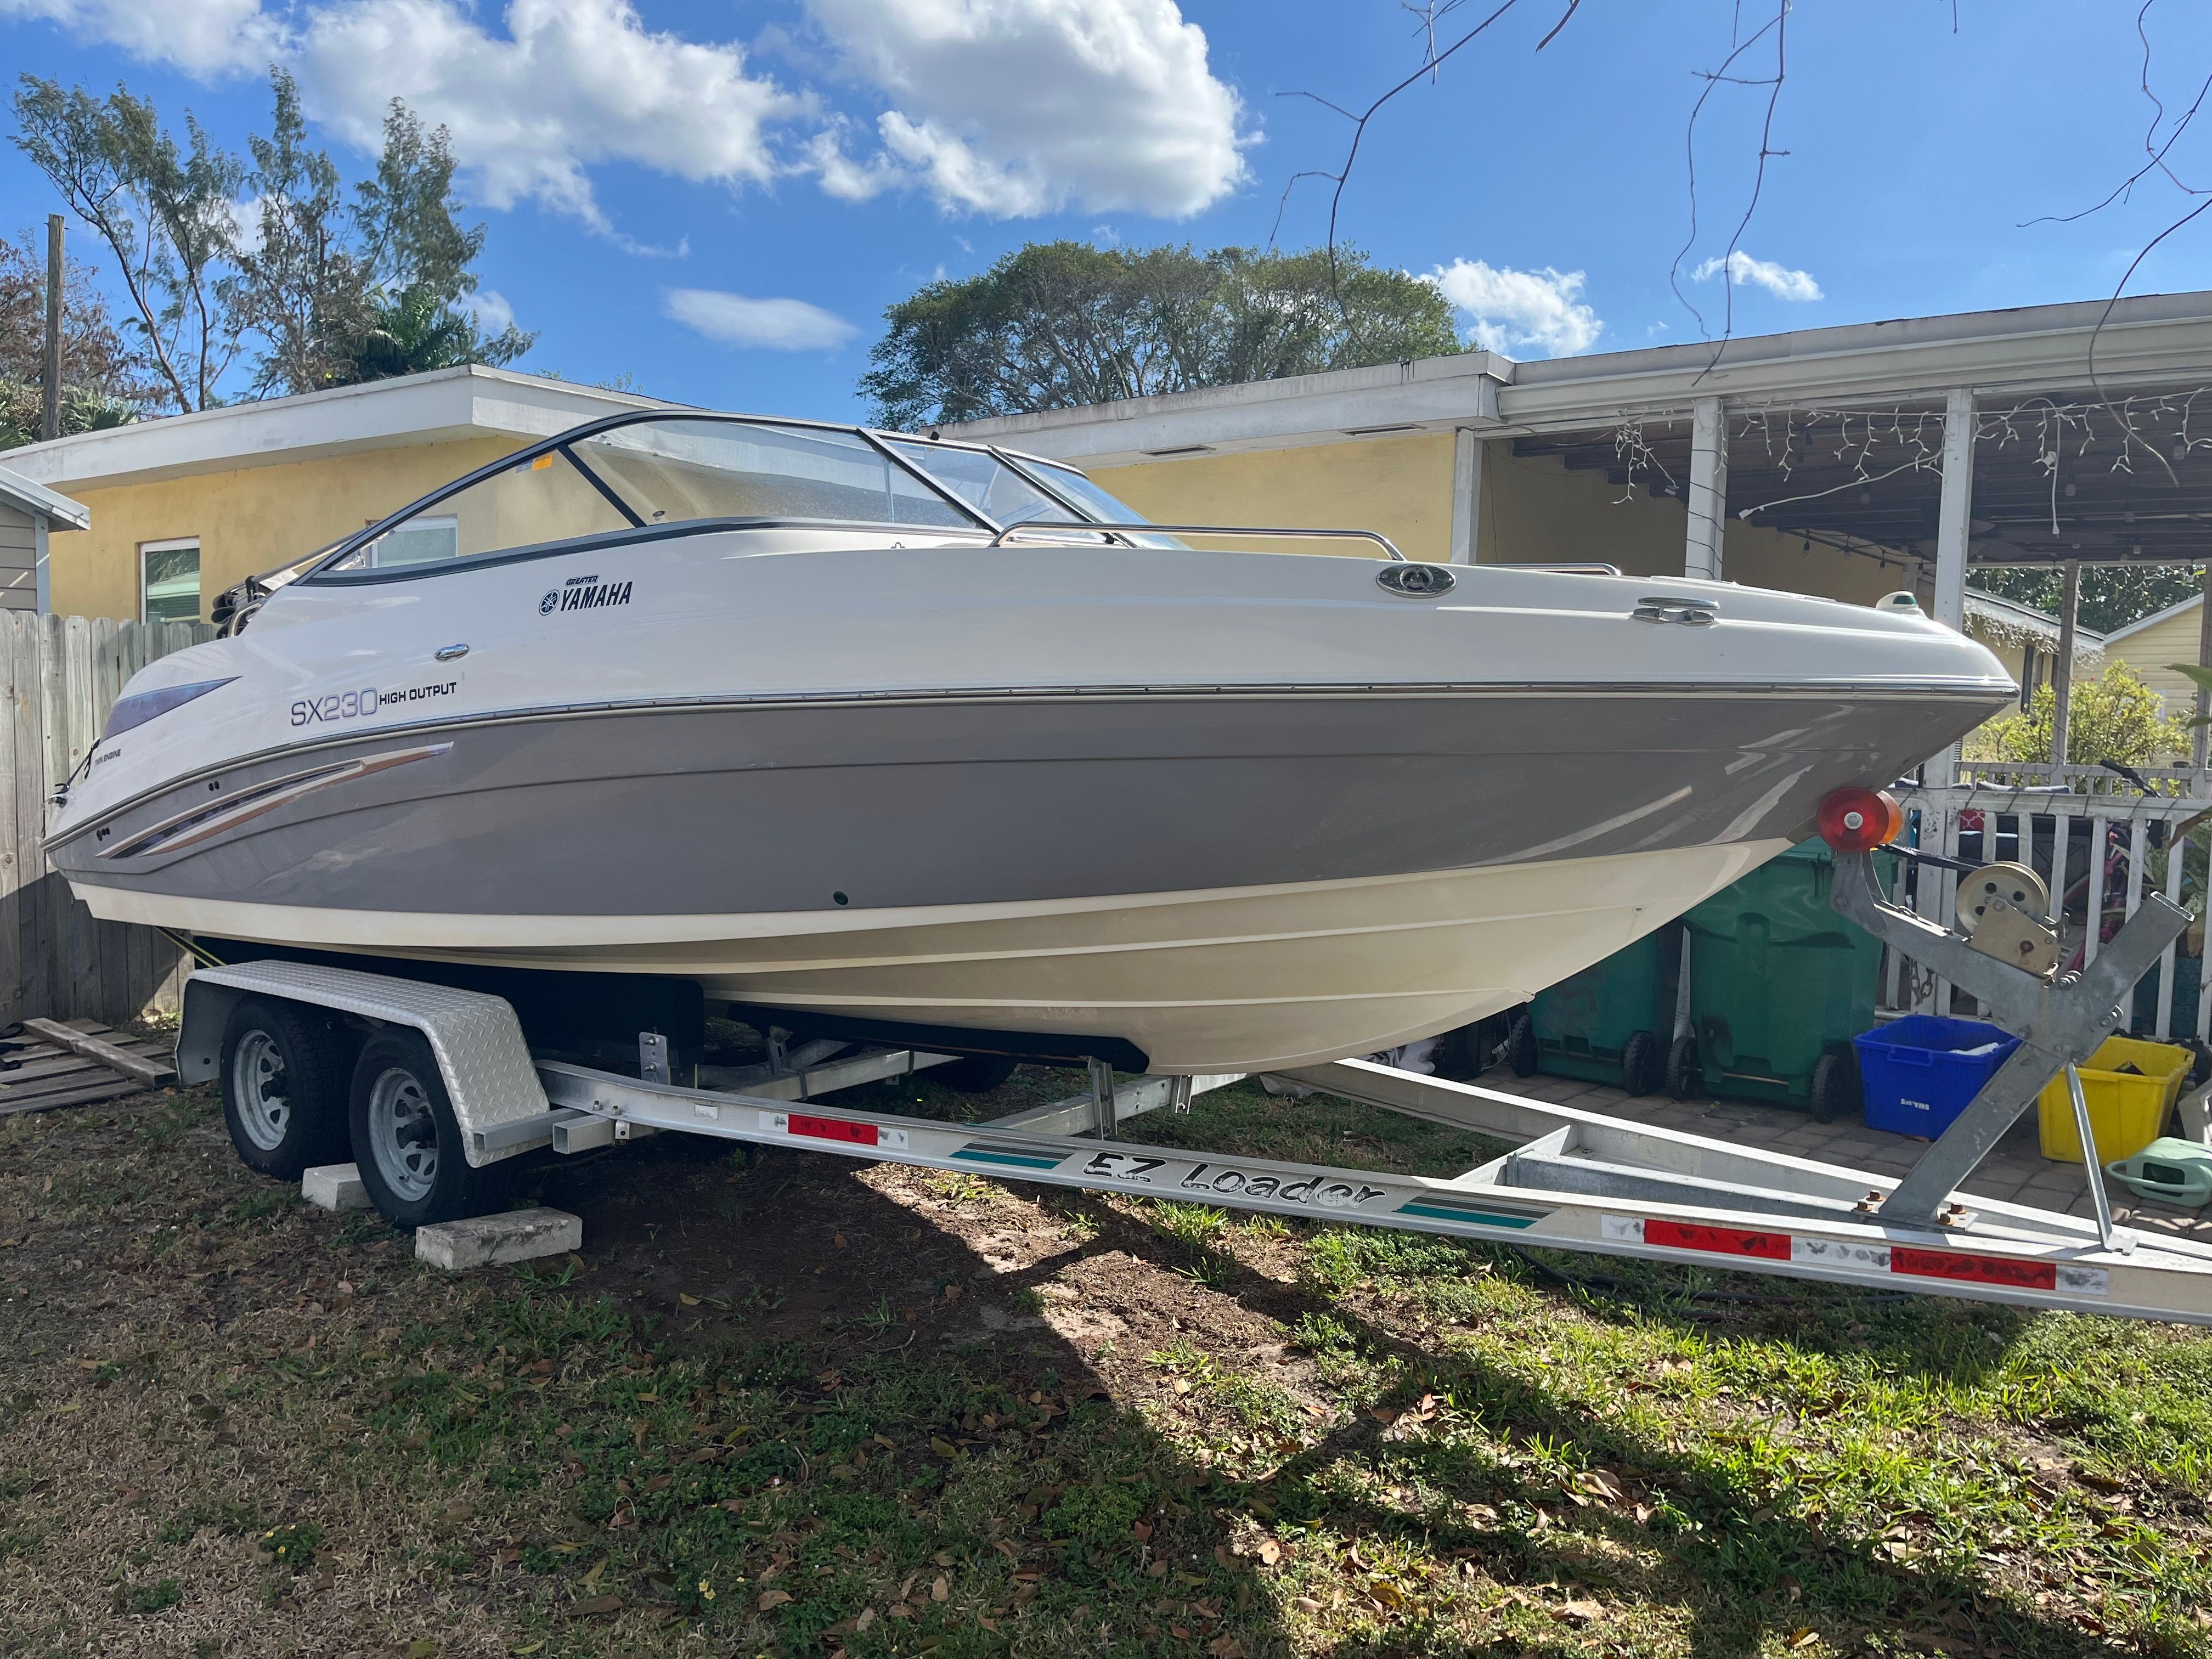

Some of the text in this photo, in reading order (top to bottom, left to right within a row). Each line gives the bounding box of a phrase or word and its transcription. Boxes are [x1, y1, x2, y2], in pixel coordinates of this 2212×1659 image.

[566, 575, 598, 585] GREATER
[560, 582, 633, 611] YAMAHA
[291, 682, 456, 725] SX230 HIGH OUTPUT
[103, 749, 121, 761] ENGINE
[1083, 1152, 1386, 1206] EZ Loader
